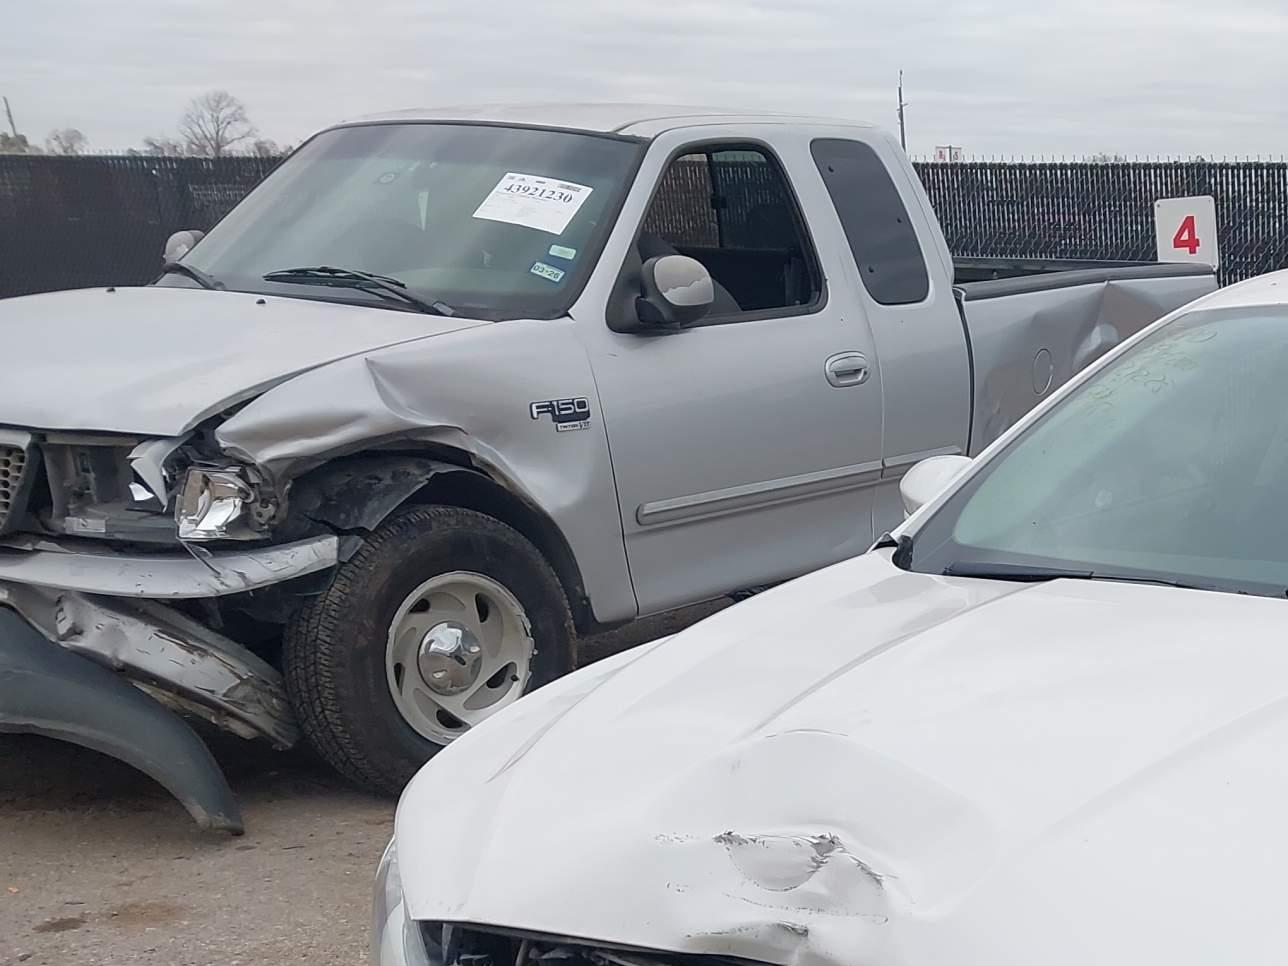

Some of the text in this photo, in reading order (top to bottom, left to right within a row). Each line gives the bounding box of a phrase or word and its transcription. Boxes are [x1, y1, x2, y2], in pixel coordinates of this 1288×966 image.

[503, 183, 573, 203] 43921230
[1173, 215, 1200, 254] 4
[531, 398, 588, 419] F-150
